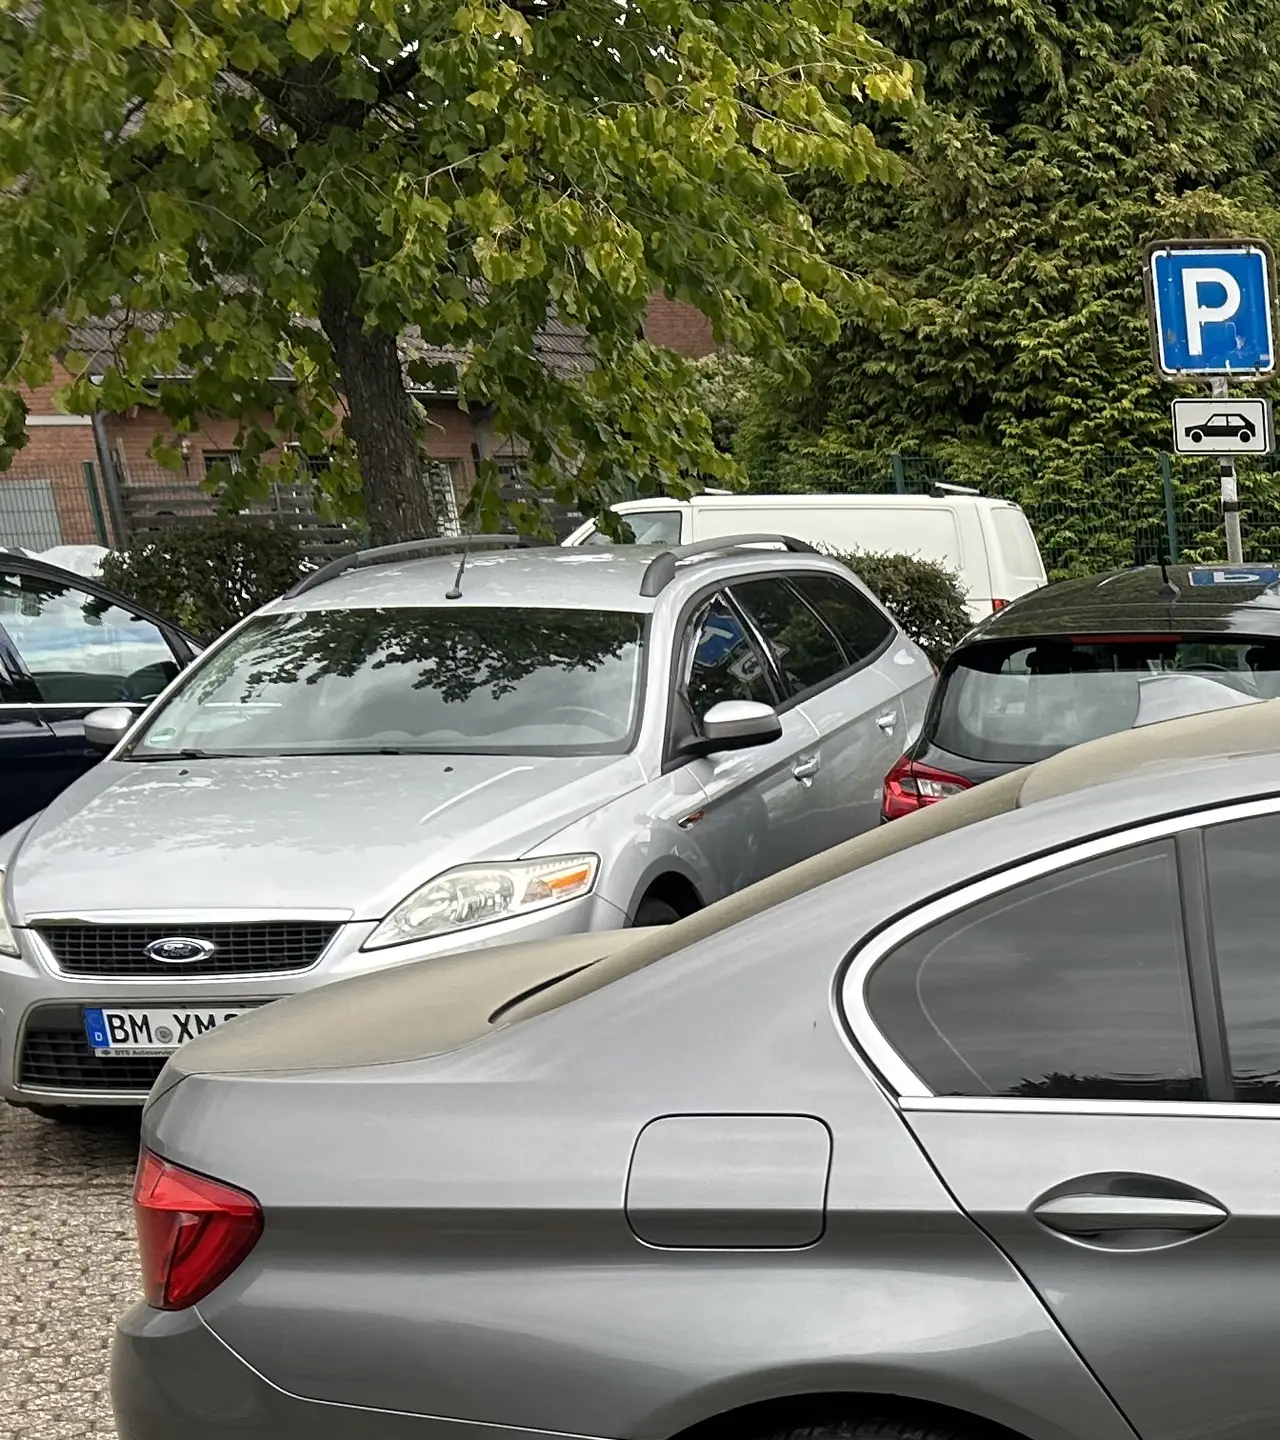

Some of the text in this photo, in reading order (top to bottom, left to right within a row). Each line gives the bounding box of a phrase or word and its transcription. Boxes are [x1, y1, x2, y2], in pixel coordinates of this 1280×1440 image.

[1181, 268, 1240, 355] P
[106, 1013, 239, 1044] BM XM
